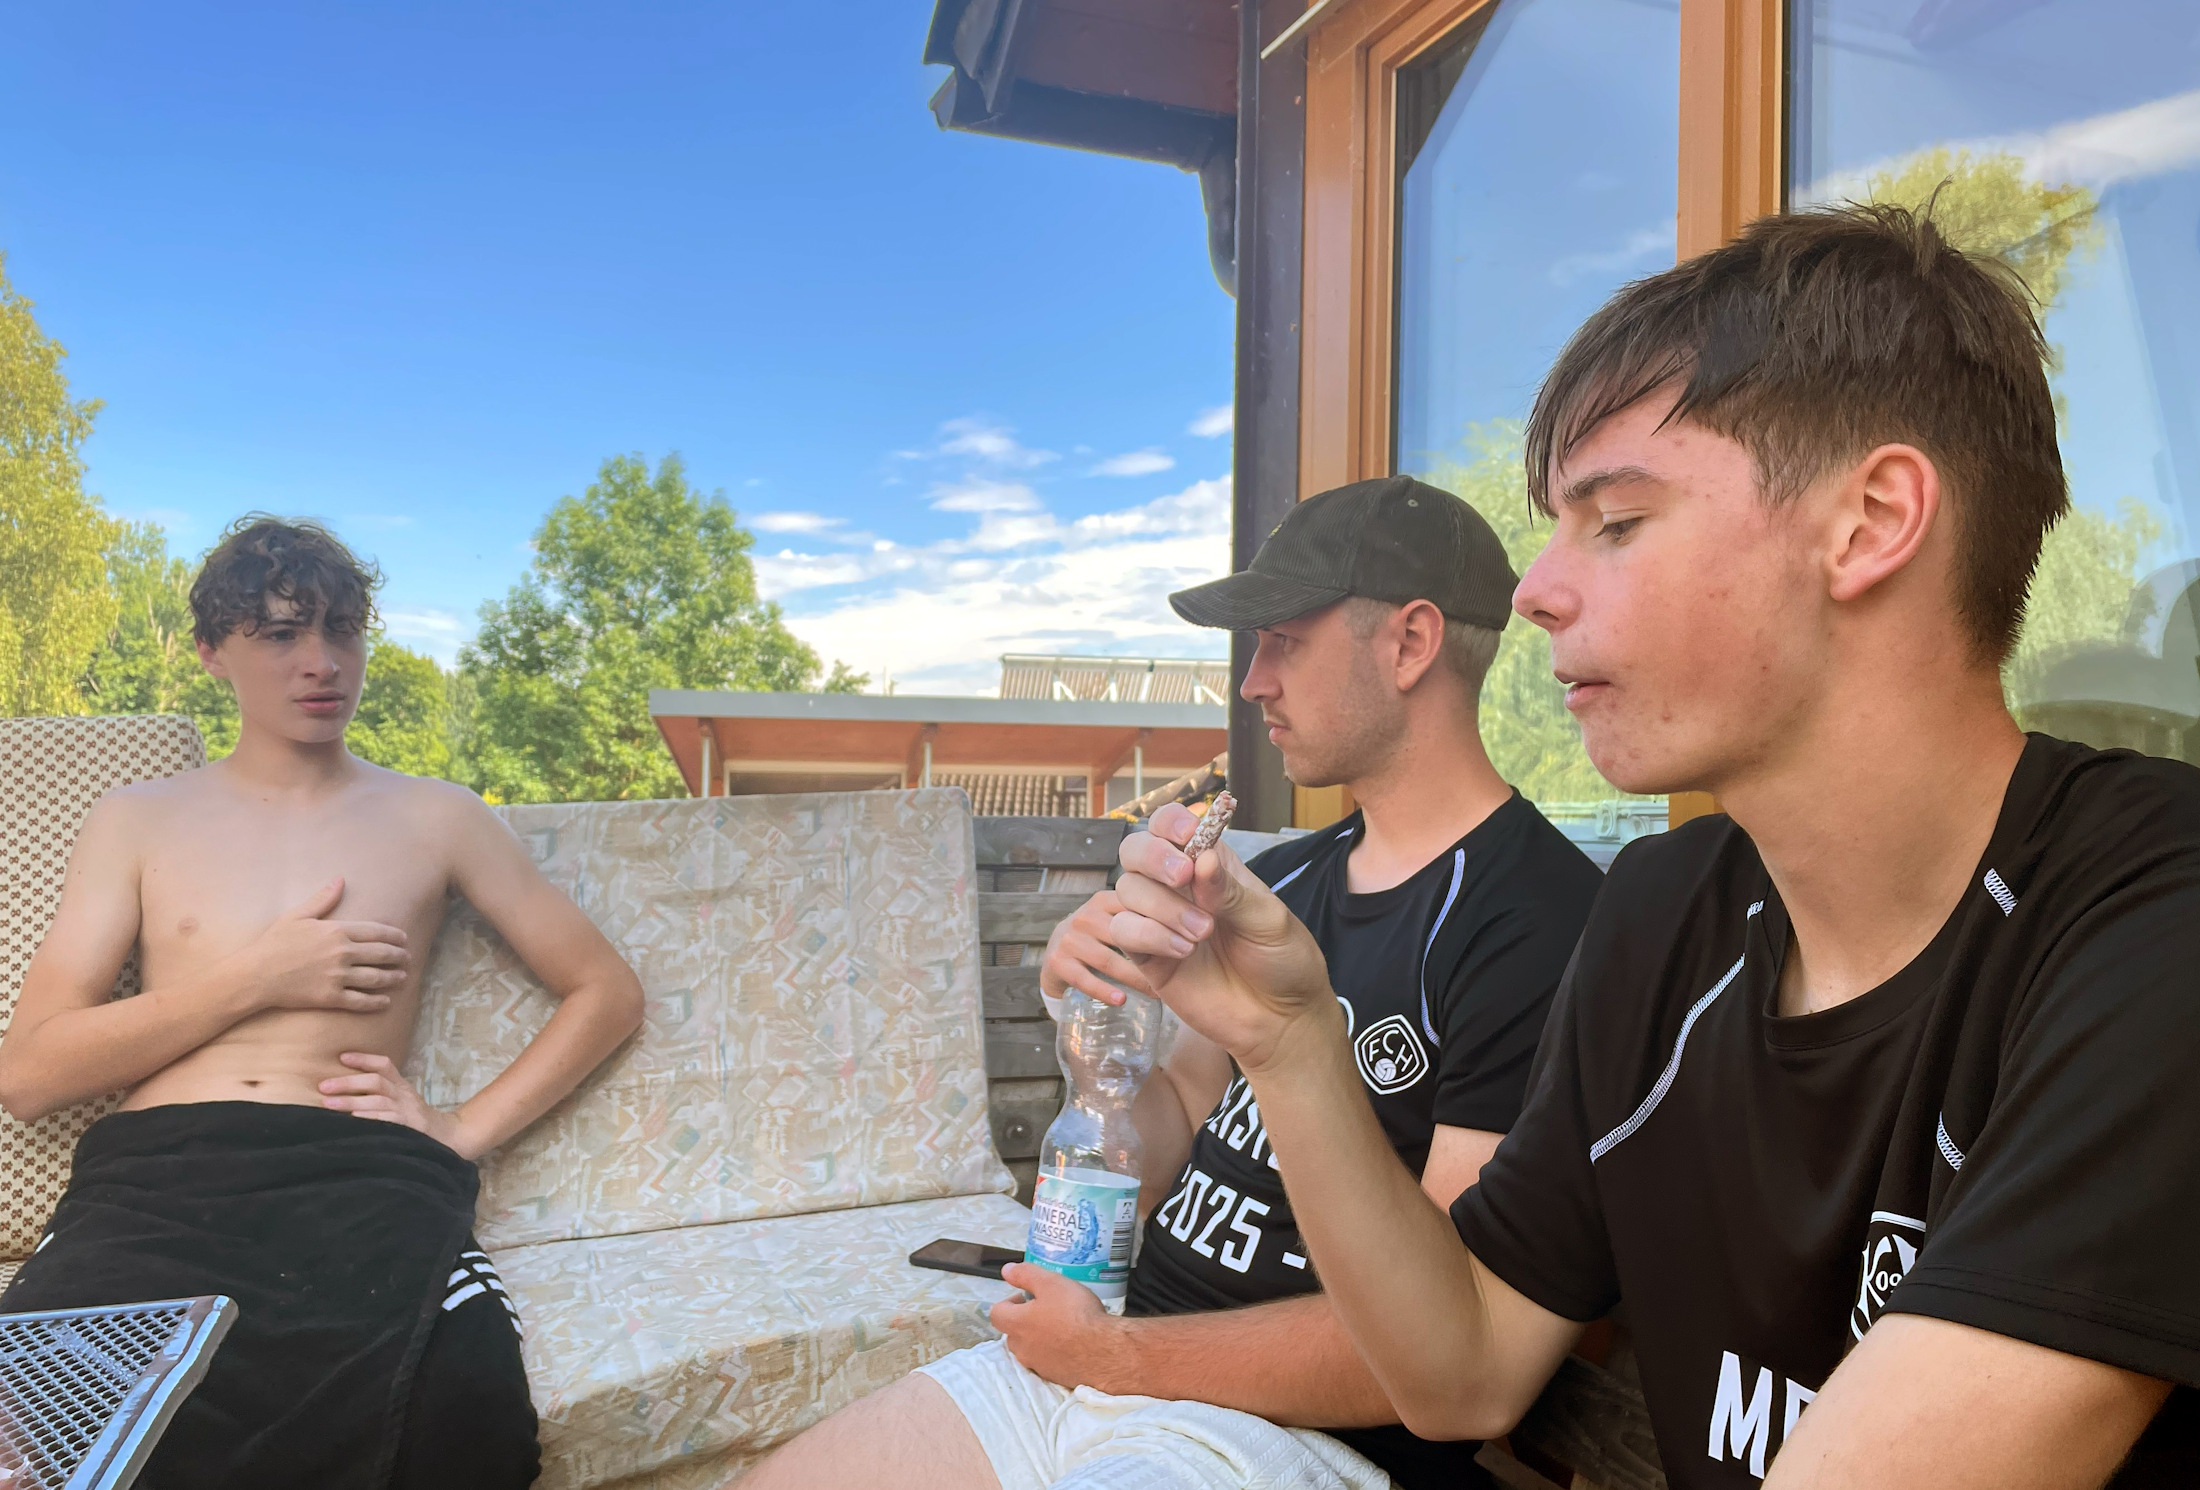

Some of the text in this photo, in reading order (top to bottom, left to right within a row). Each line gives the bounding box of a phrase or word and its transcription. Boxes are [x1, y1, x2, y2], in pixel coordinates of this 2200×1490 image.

[1035, 1204, 1087, 1230] MINERAL
[1156, 1163, 1271, 1273] 2025
[1035, 1221, 1074, 1242] WASSER
